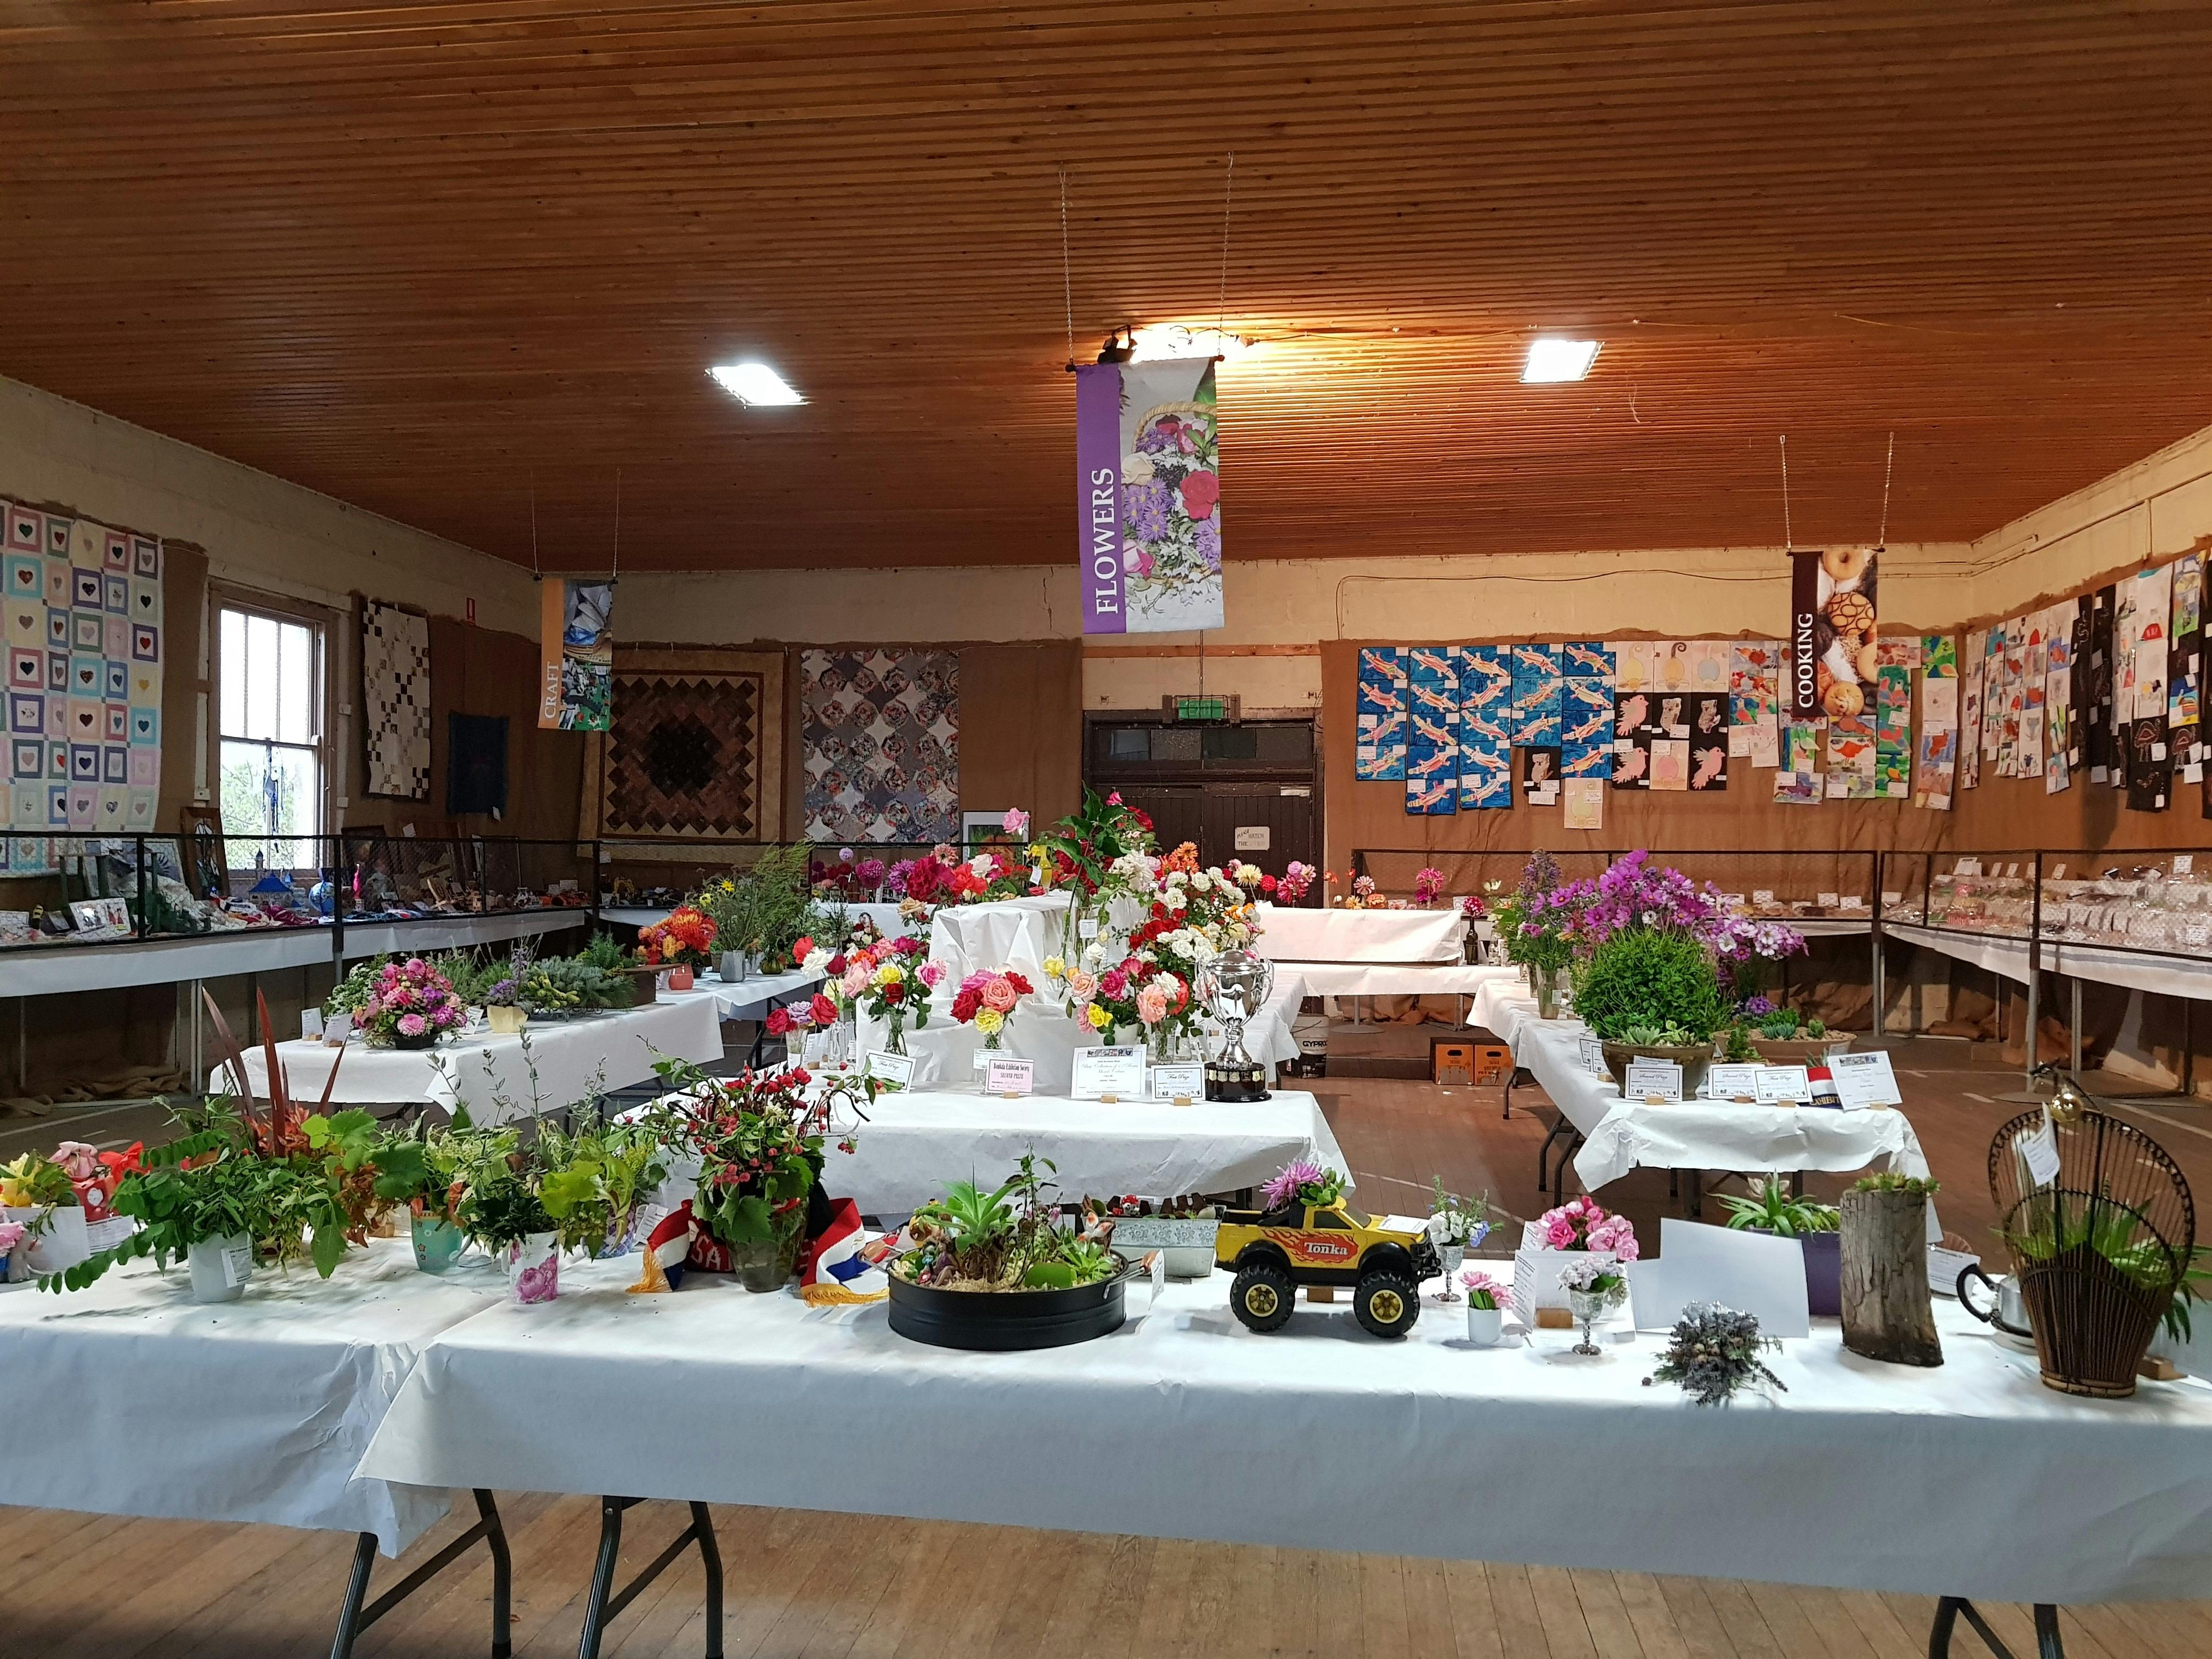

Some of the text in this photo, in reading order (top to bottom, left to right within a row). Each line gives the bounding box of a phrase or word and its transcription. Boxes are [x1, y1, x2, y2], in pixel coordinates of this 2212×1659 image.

[1091, 467, 1119, 615] FLOWERS
[1798, 613, 1814, 708] COOKING
[544, 661, 560, 719] CRAFT
[1188, 702, 1212, 715] EXIT
[1020, 1064, 1030, 1073] Society
[1304, 1241, 1348, 1256] Tonka
